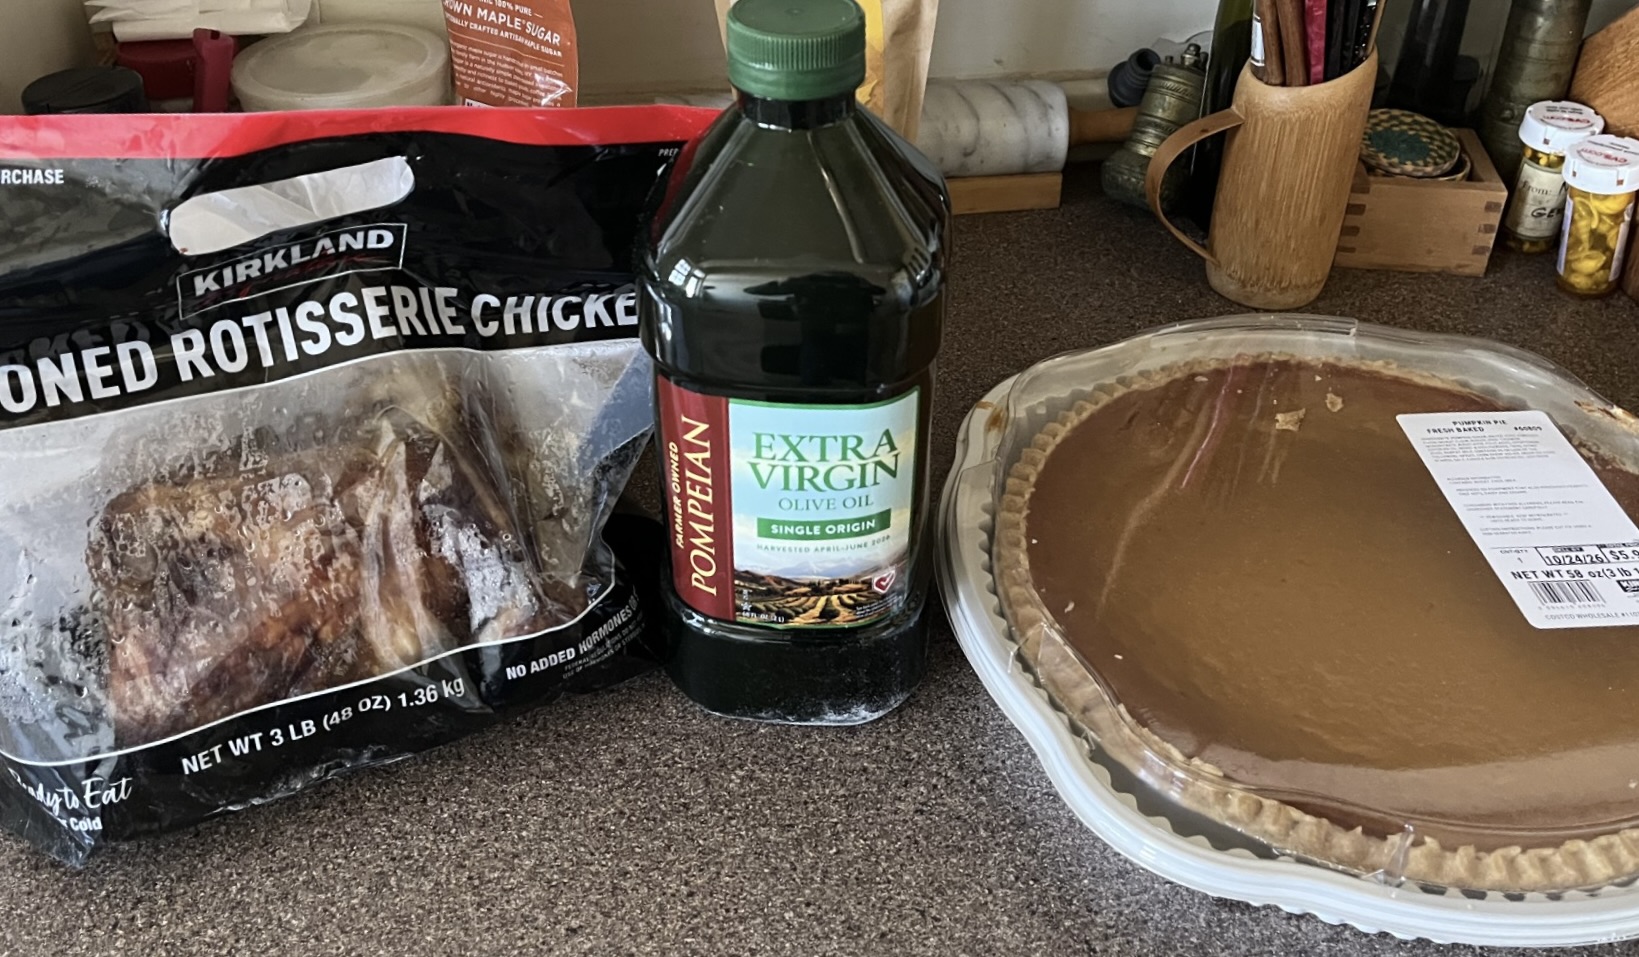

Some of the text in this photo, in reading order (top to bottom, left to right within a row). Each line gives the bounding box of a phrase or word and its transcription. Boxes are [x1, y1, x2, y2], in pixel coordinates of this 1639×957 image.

[469, 22, 498, 36] CRAFTED
[540, 45, 562, 57] SUGAR
[525, 21, 560, 46] SUGAR
[0, 169, 65, 184] RCHASE
[193, 229, 395, 297] KIRKLAND
[0, 287, 639, 413] ONED ROTISSERIE CHICKE
[752, 428, 898, 463] EXTRA
[747, 451, 902, 493] VIRGIN
[669, 442, 684, 549] FARMER OWNED
[681, 415, 717, 596] POMPEIAN
[778, 494, 874, 511] OLIVE OIL
[770, 519, 876, 535] SINGLE ORIGIN
[756, 543, 810, 553] HARVESTED
[814, 541, 868, 552] APRIL-JUNE
[1545, 553, 1604, 565] 10/24/26
[1510, 570, 1538, 579] NET
[1541, 569, 1564, 578] WT
[1566, 569, 1584, 578] 58
[1616, 567, 1632, 577] lb
[1577, 612, 1618, 620] WHOLESALE
[505, 604, 632, 680] NO ADDED HORMONES
[181, 677, 465, 775] NET WT 3 LB (48 OZ) 1.36 kg
[55, 786, 80, 810] to
[81, 777, 133, 809] Eat
[69, 816, 103, 831] Cold
